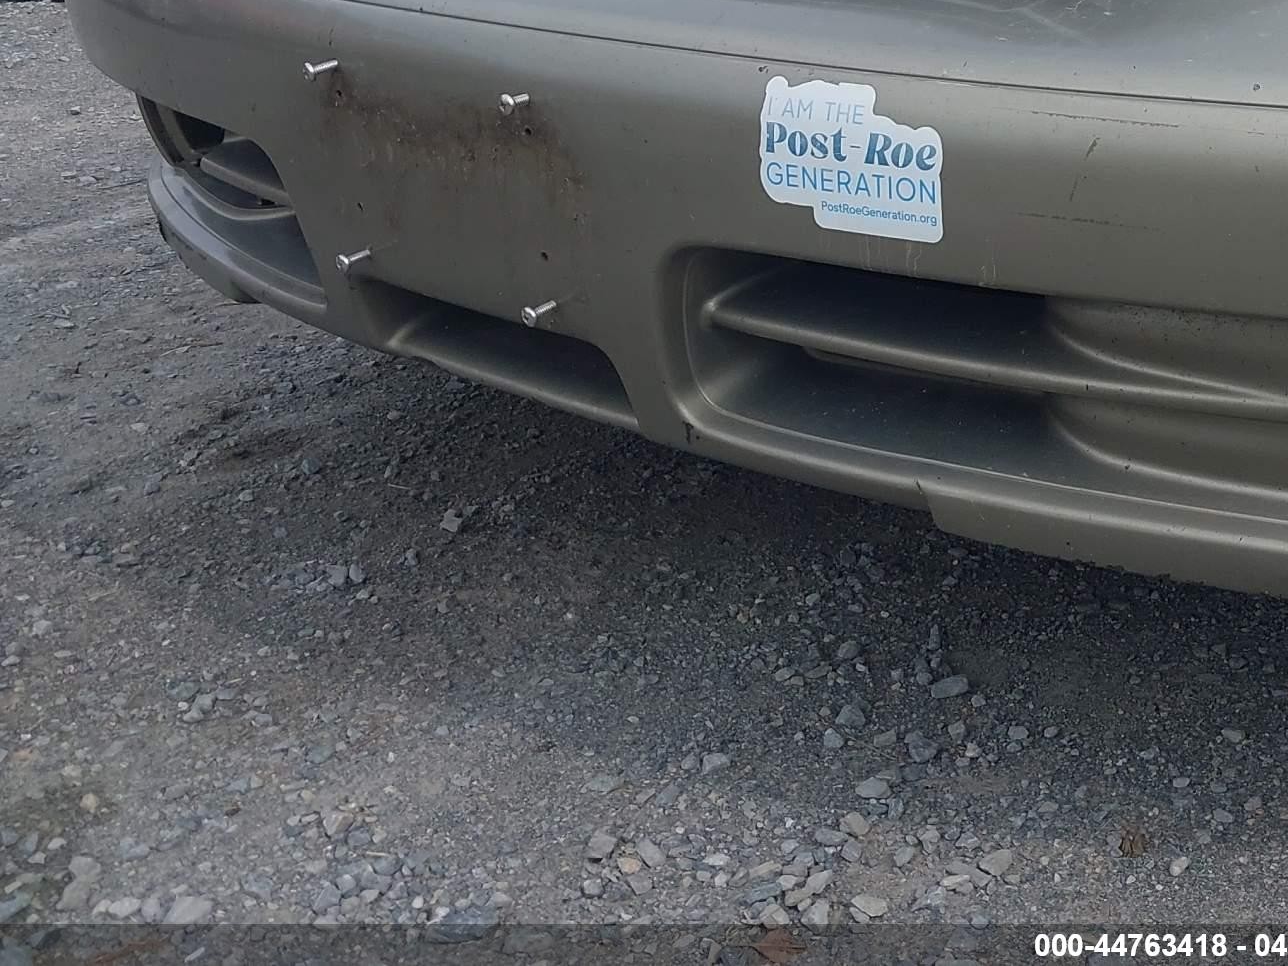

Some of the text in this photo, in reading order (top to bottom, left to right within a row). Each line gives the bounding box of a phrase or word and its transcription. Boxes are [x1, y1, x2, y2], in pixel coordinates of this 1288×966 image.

[767, 97, 865, 125] I AM THE
[765, 121, 937, 171] Post-Roe
[766, 162, 937, 204] GENERATION
[821, 200, 938, 227] PostRoeGeneration.org
